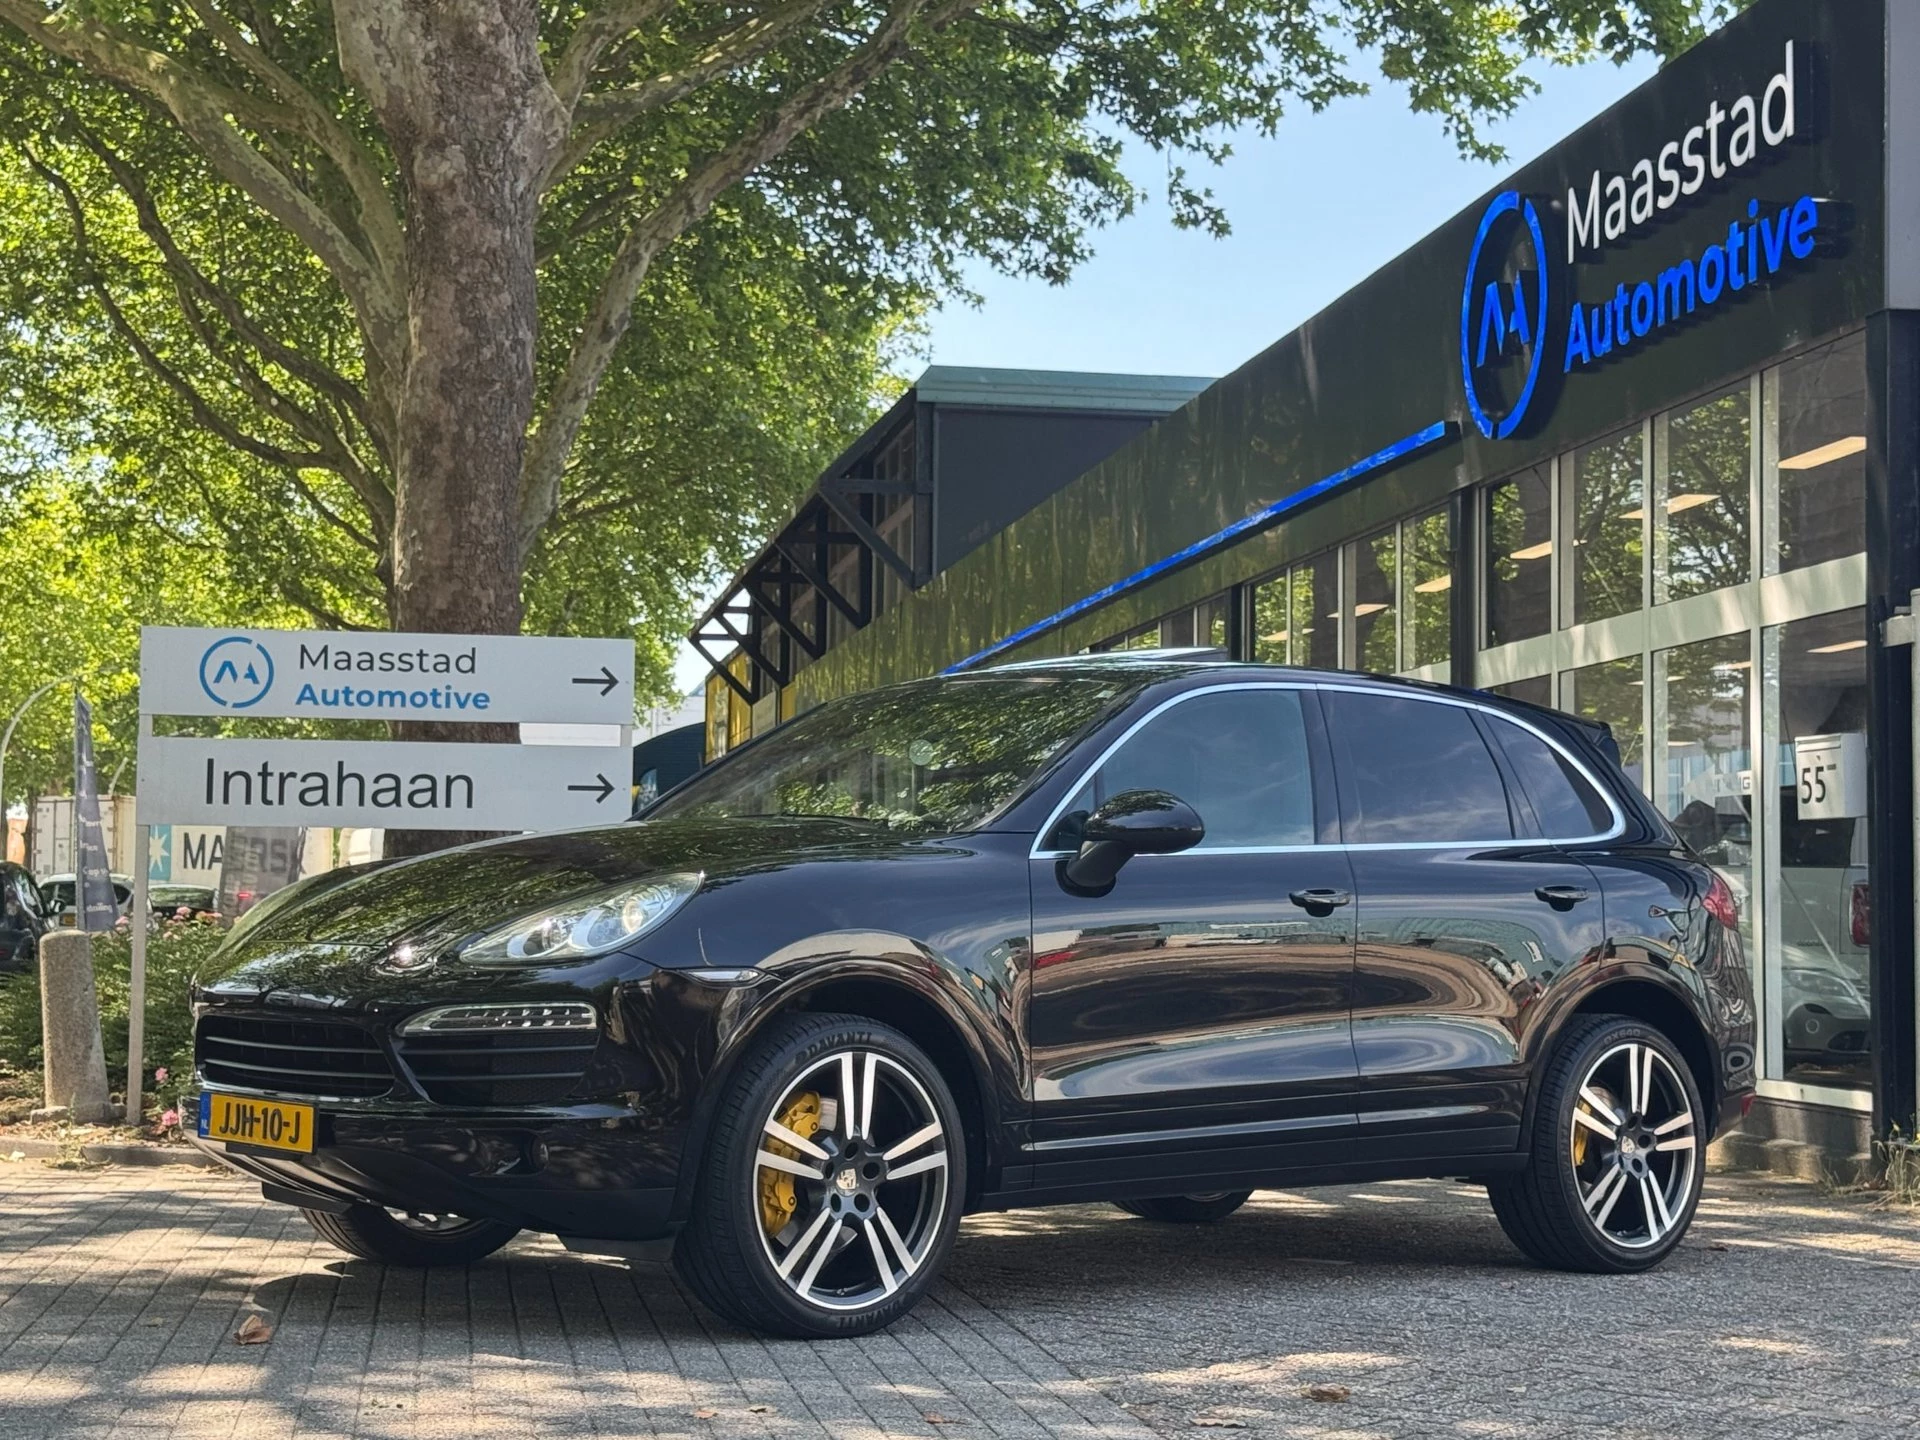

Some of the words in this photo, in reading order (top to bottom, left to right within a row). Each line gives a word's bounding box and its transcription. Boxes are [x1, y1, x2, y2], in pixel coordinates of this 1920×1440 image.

[1567, 39, 1795, 265] Maasstad
[1563, 196, 1818, 374] Automotive
[299, 644, 477, 674] Maasstad
[295, 684, 491, 710] Automotive
[205, 758, 474, 809] Intrahaan
[1801, 765, 1826, 805] 55
[183, 832, 306, 874] MARSK
[219, 1102, 300, 1144] JJH-10-J
